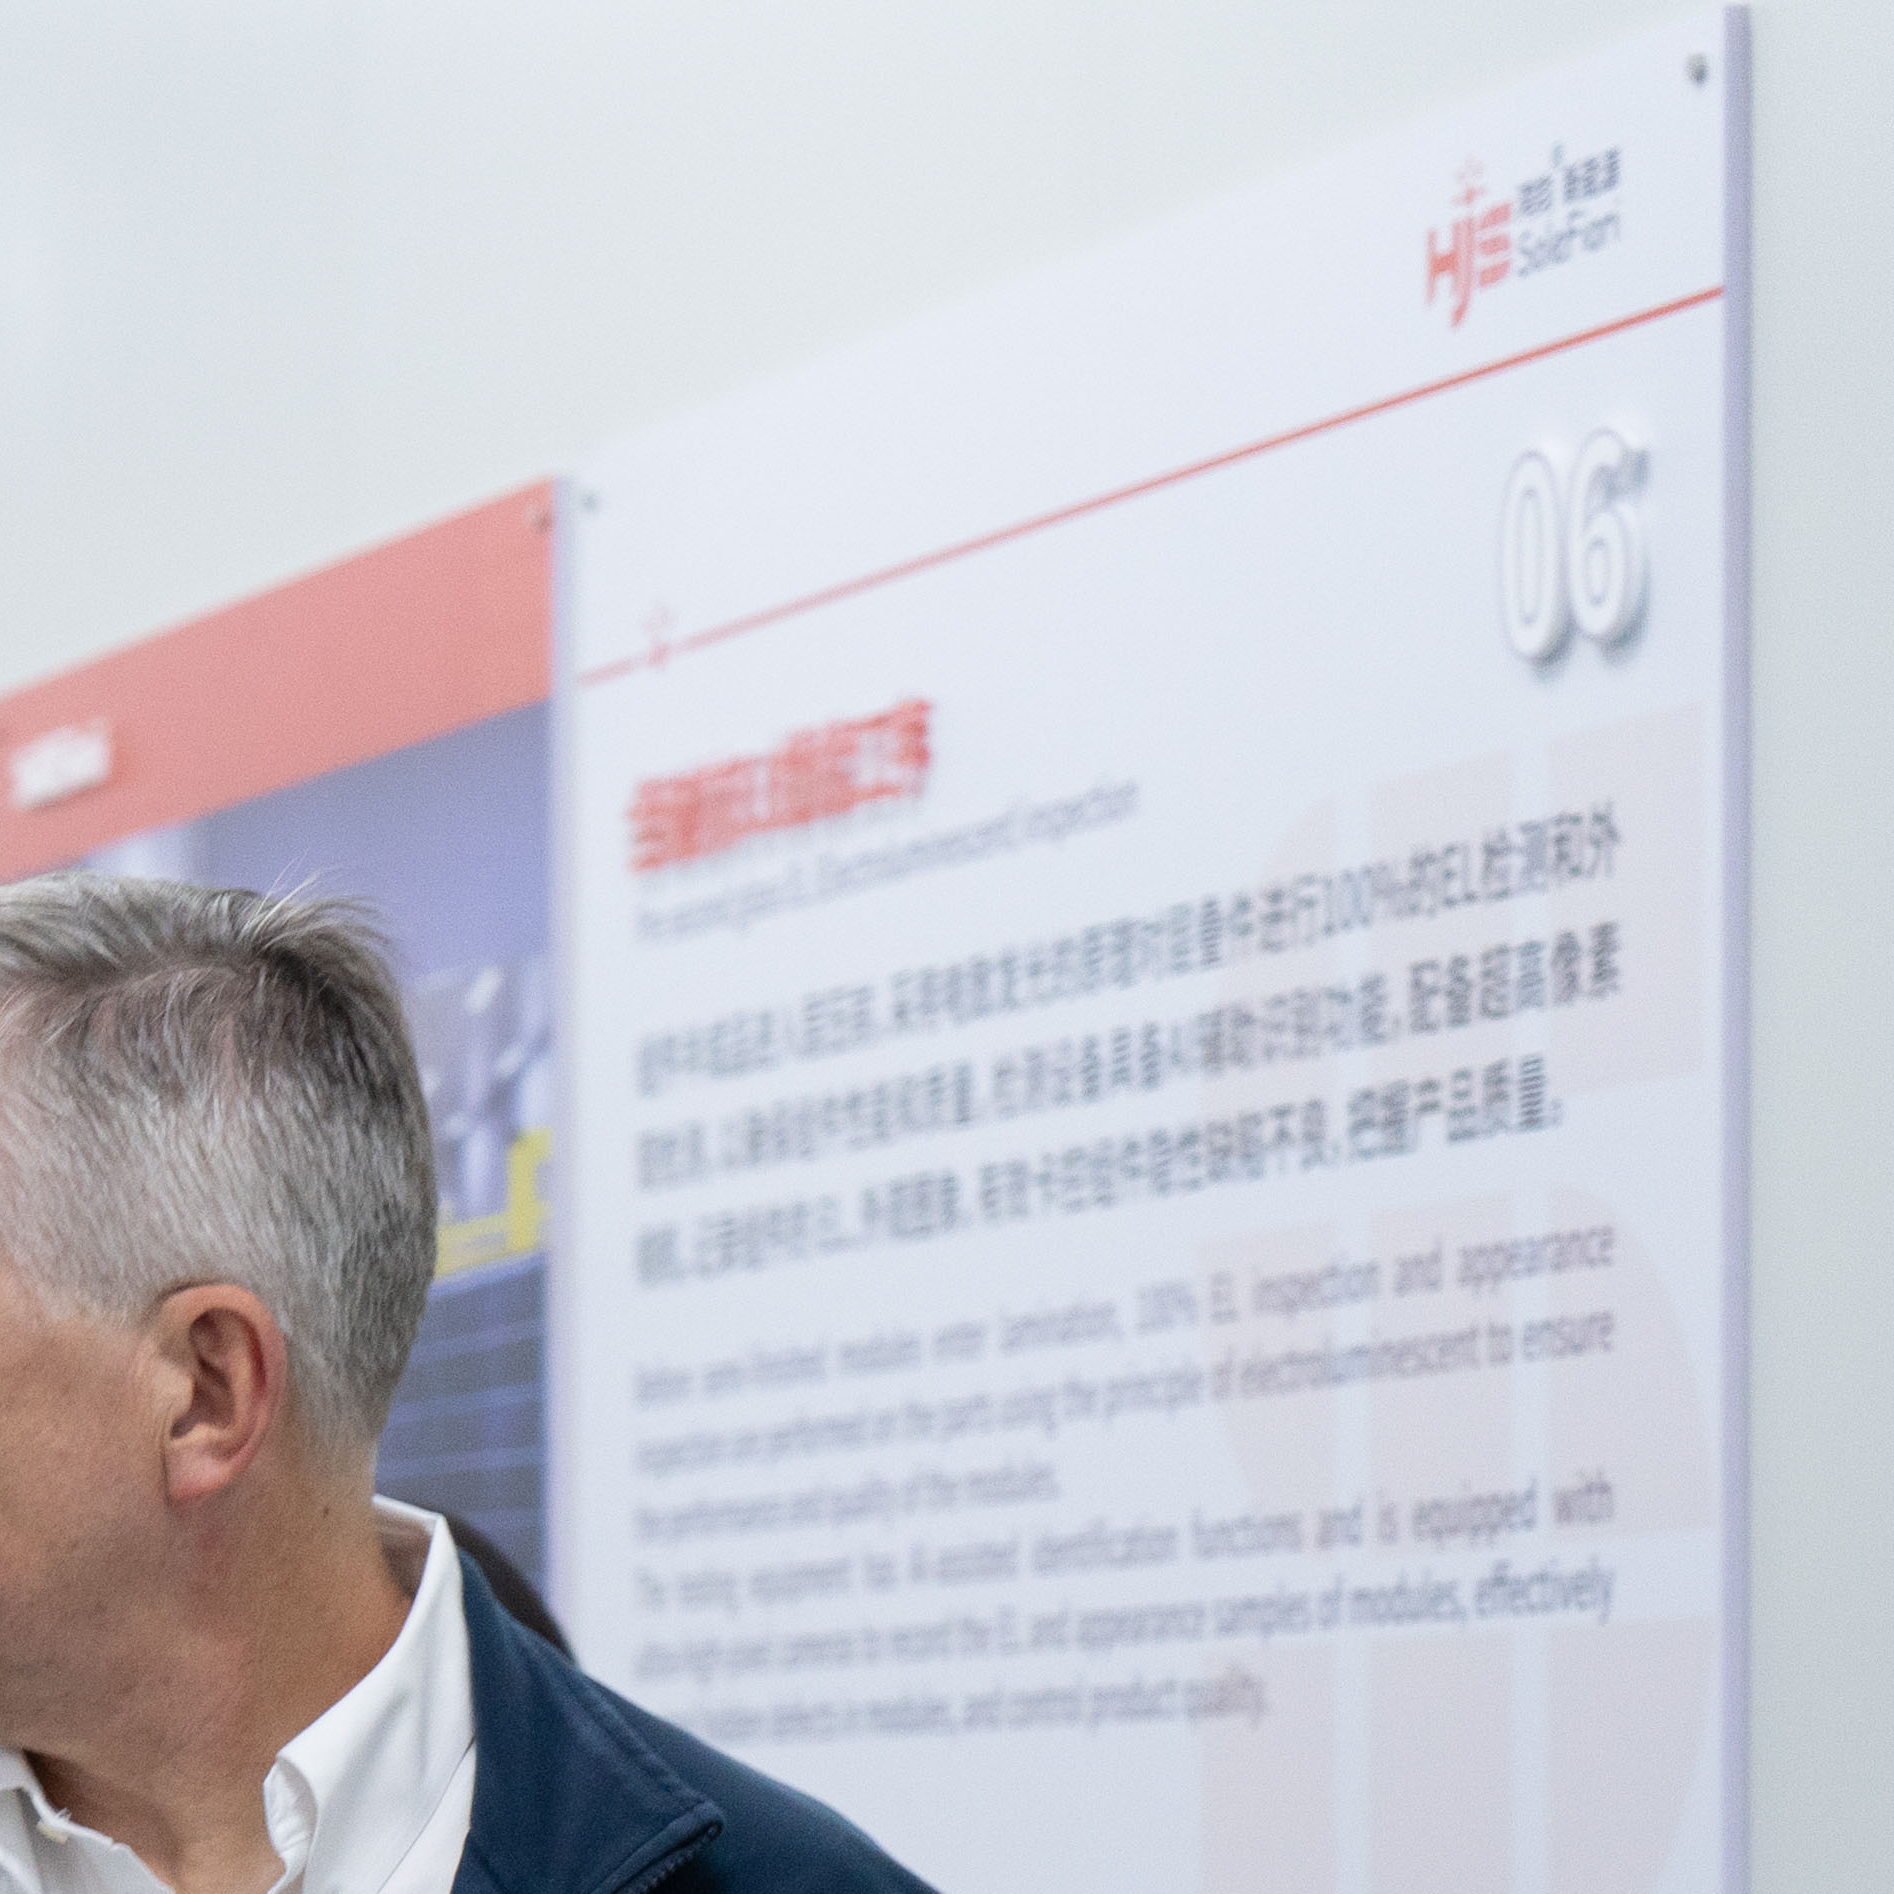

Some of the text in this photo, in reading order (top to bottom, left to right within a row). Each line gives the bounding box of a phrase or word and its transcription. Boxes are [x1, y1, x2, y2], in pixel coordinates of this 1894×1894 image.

[1499, 426, 1647, 668] 06
[1253, 1252, 1379, 1325] inspection
[1393, 1237, 1443, 1295] and
[1457, 1221, 1614, 1298] appearance
[1238, 1313, 1479, 1399] electroluminescent
[1486, 1311, 1513, 1366] to
[1520, 1307, 1614, 1362] ensure
[1315, 1490, 1362, 1547] and
[1376, 1488, 1399, 1541] is
[1412, 1471, 1538, 1550] equipped
[1552, 1463, 1615, 1524] with
[1317, 1574, 1342, 1627] of
[1349, 1566, 1464, 1624] modules,
[1474, 1550, 1616, 1622] effectively
